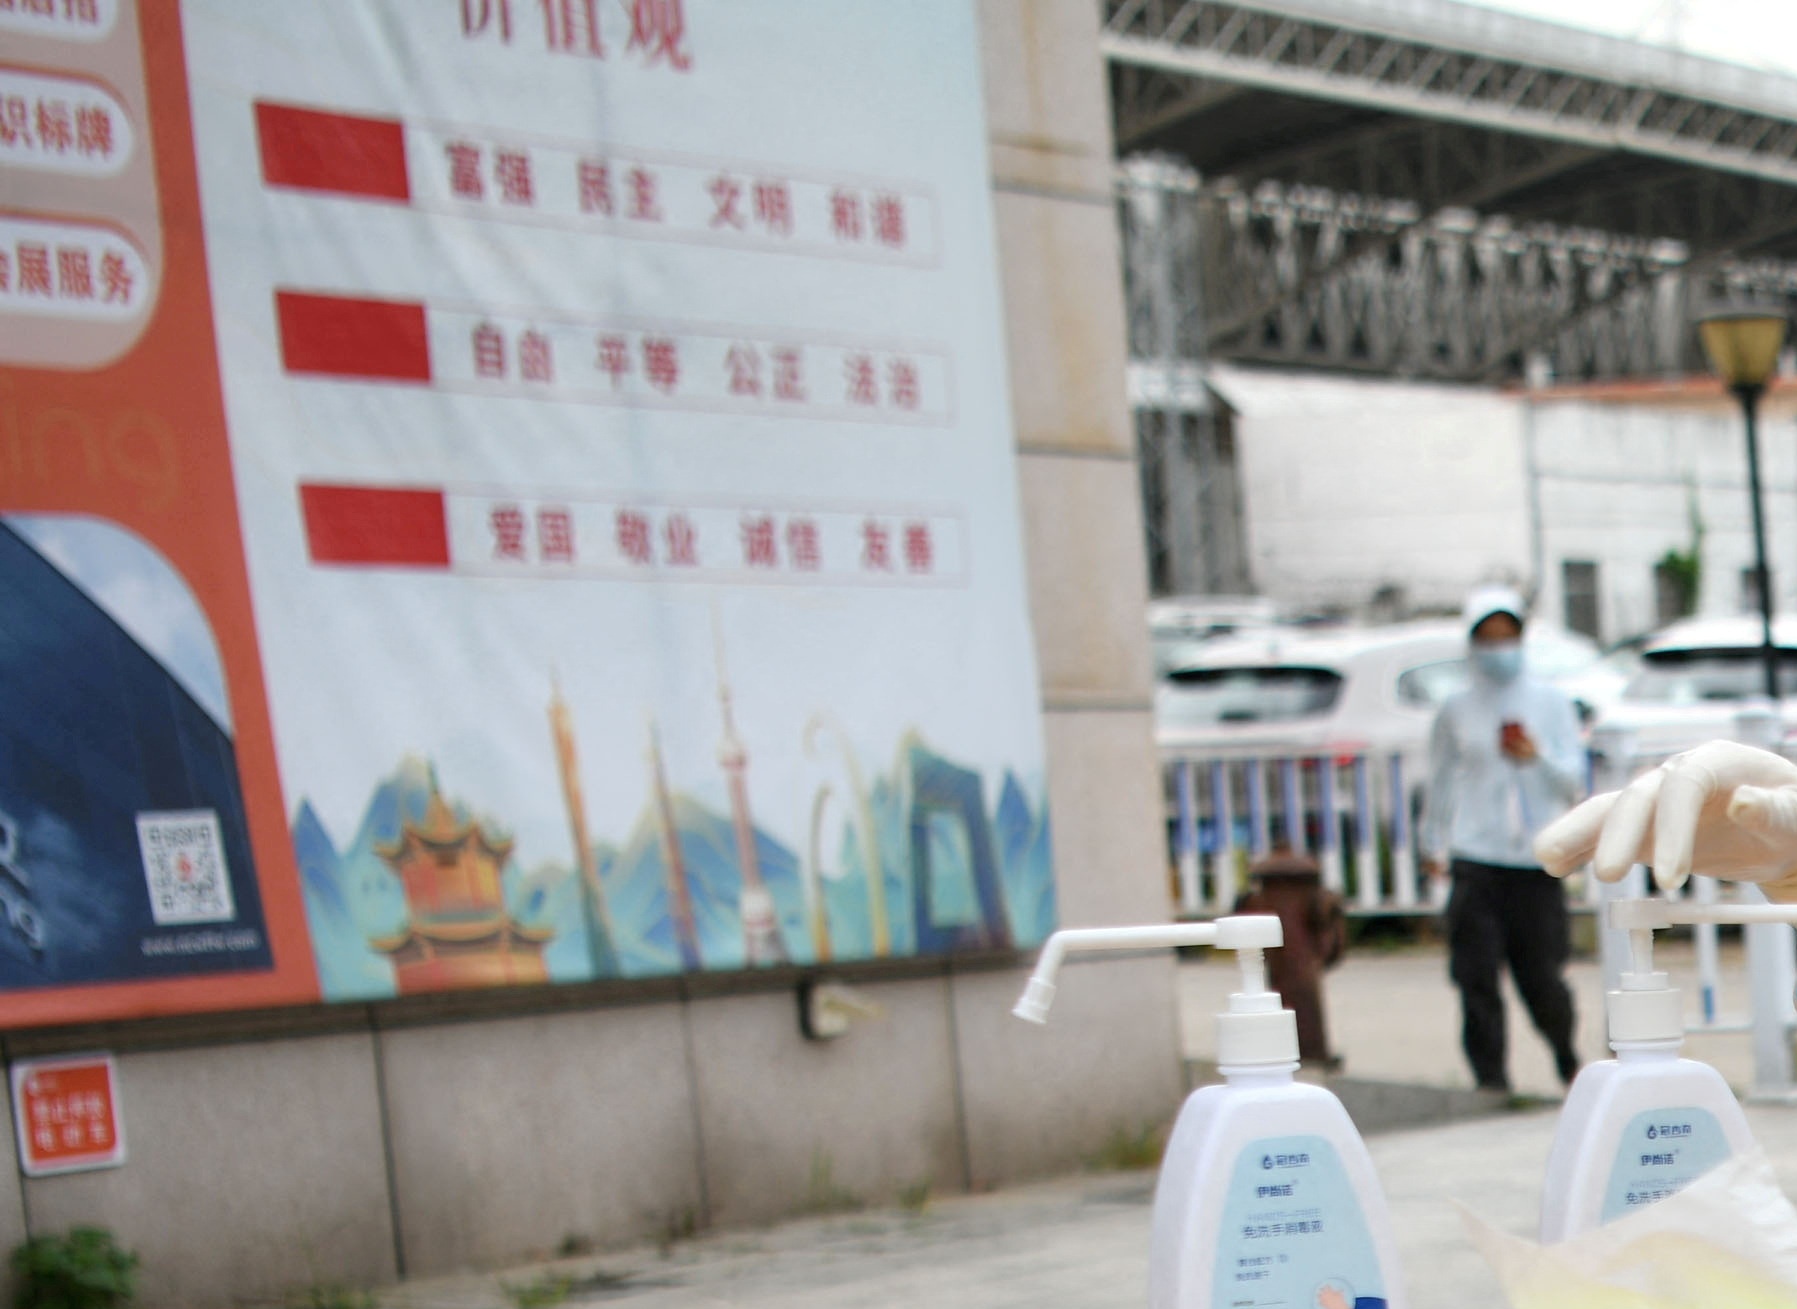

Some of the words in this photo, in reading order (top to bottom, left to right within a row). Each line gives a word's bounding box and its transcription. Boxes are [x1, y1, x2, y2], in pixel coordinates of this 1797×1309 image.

[446, 140, 536, 206] 富强
[576, 156, 663, 223] 民主
[708, 172, 794, 238] 文明
[828, 185, 907, 248] 和谐
[472, 318, 556, 385] 自由
[596, 333, 681, 397] 平等
[724, 340, 808, 402] 公正
[845, 350, 922, 411] 法治
[490, 504, 577, 566] 爱国
[615, 508, 699, 567] 敬业
[740, 511, 822, 571] 诚信
[861, 515, 935, 574] 友善
